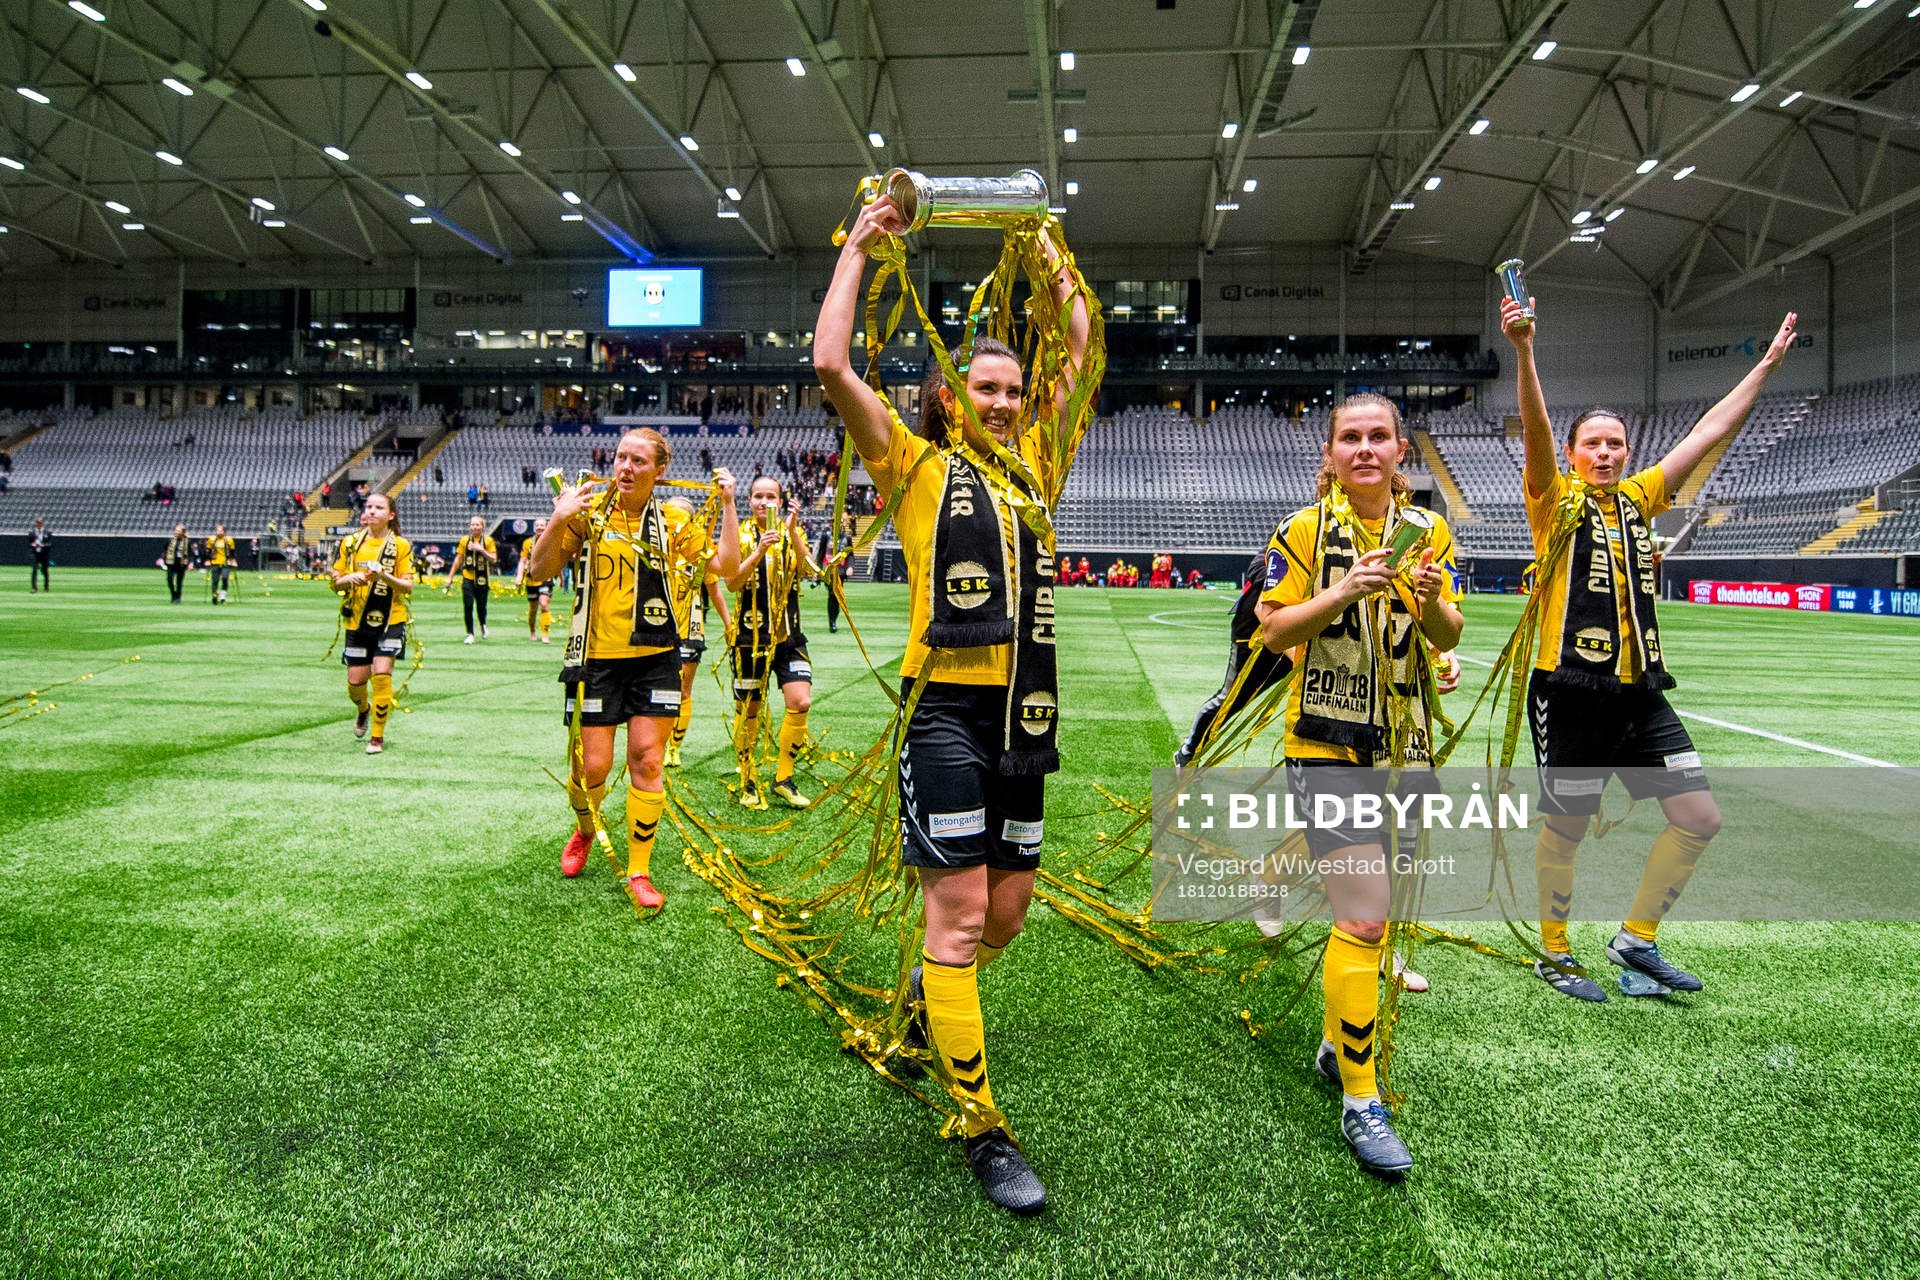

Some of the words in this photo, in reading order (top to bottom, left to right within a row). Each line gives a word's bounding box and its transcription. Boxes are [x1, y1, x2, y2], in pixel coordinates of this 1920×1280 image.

[1244, 286, 1280, 298] Canal
[1282, 286, 1324, 300] Digital
[1668, 344, 1729, 362] telenor
[1758, 335, 1814, 353] ana
[946, 577, 990, 593] LSK
[1716, 585, 1791, 606] thonhotels.no
[1798, 590, 1821, 602] THON
[1836, 590, 1856, 600] REMA
[1798, 602, 1820, 611] HOTELS
[1838, 600, 1855, 610] 1000
[1890, 591, 1902, 614] VI
[643, 606, 668, 617] LSK
[1575, 637, 1613, 652] LSK
[1305, 692, 1367, 713] CUPFINALEN
[1022, 706, 1056, 719] LSK
